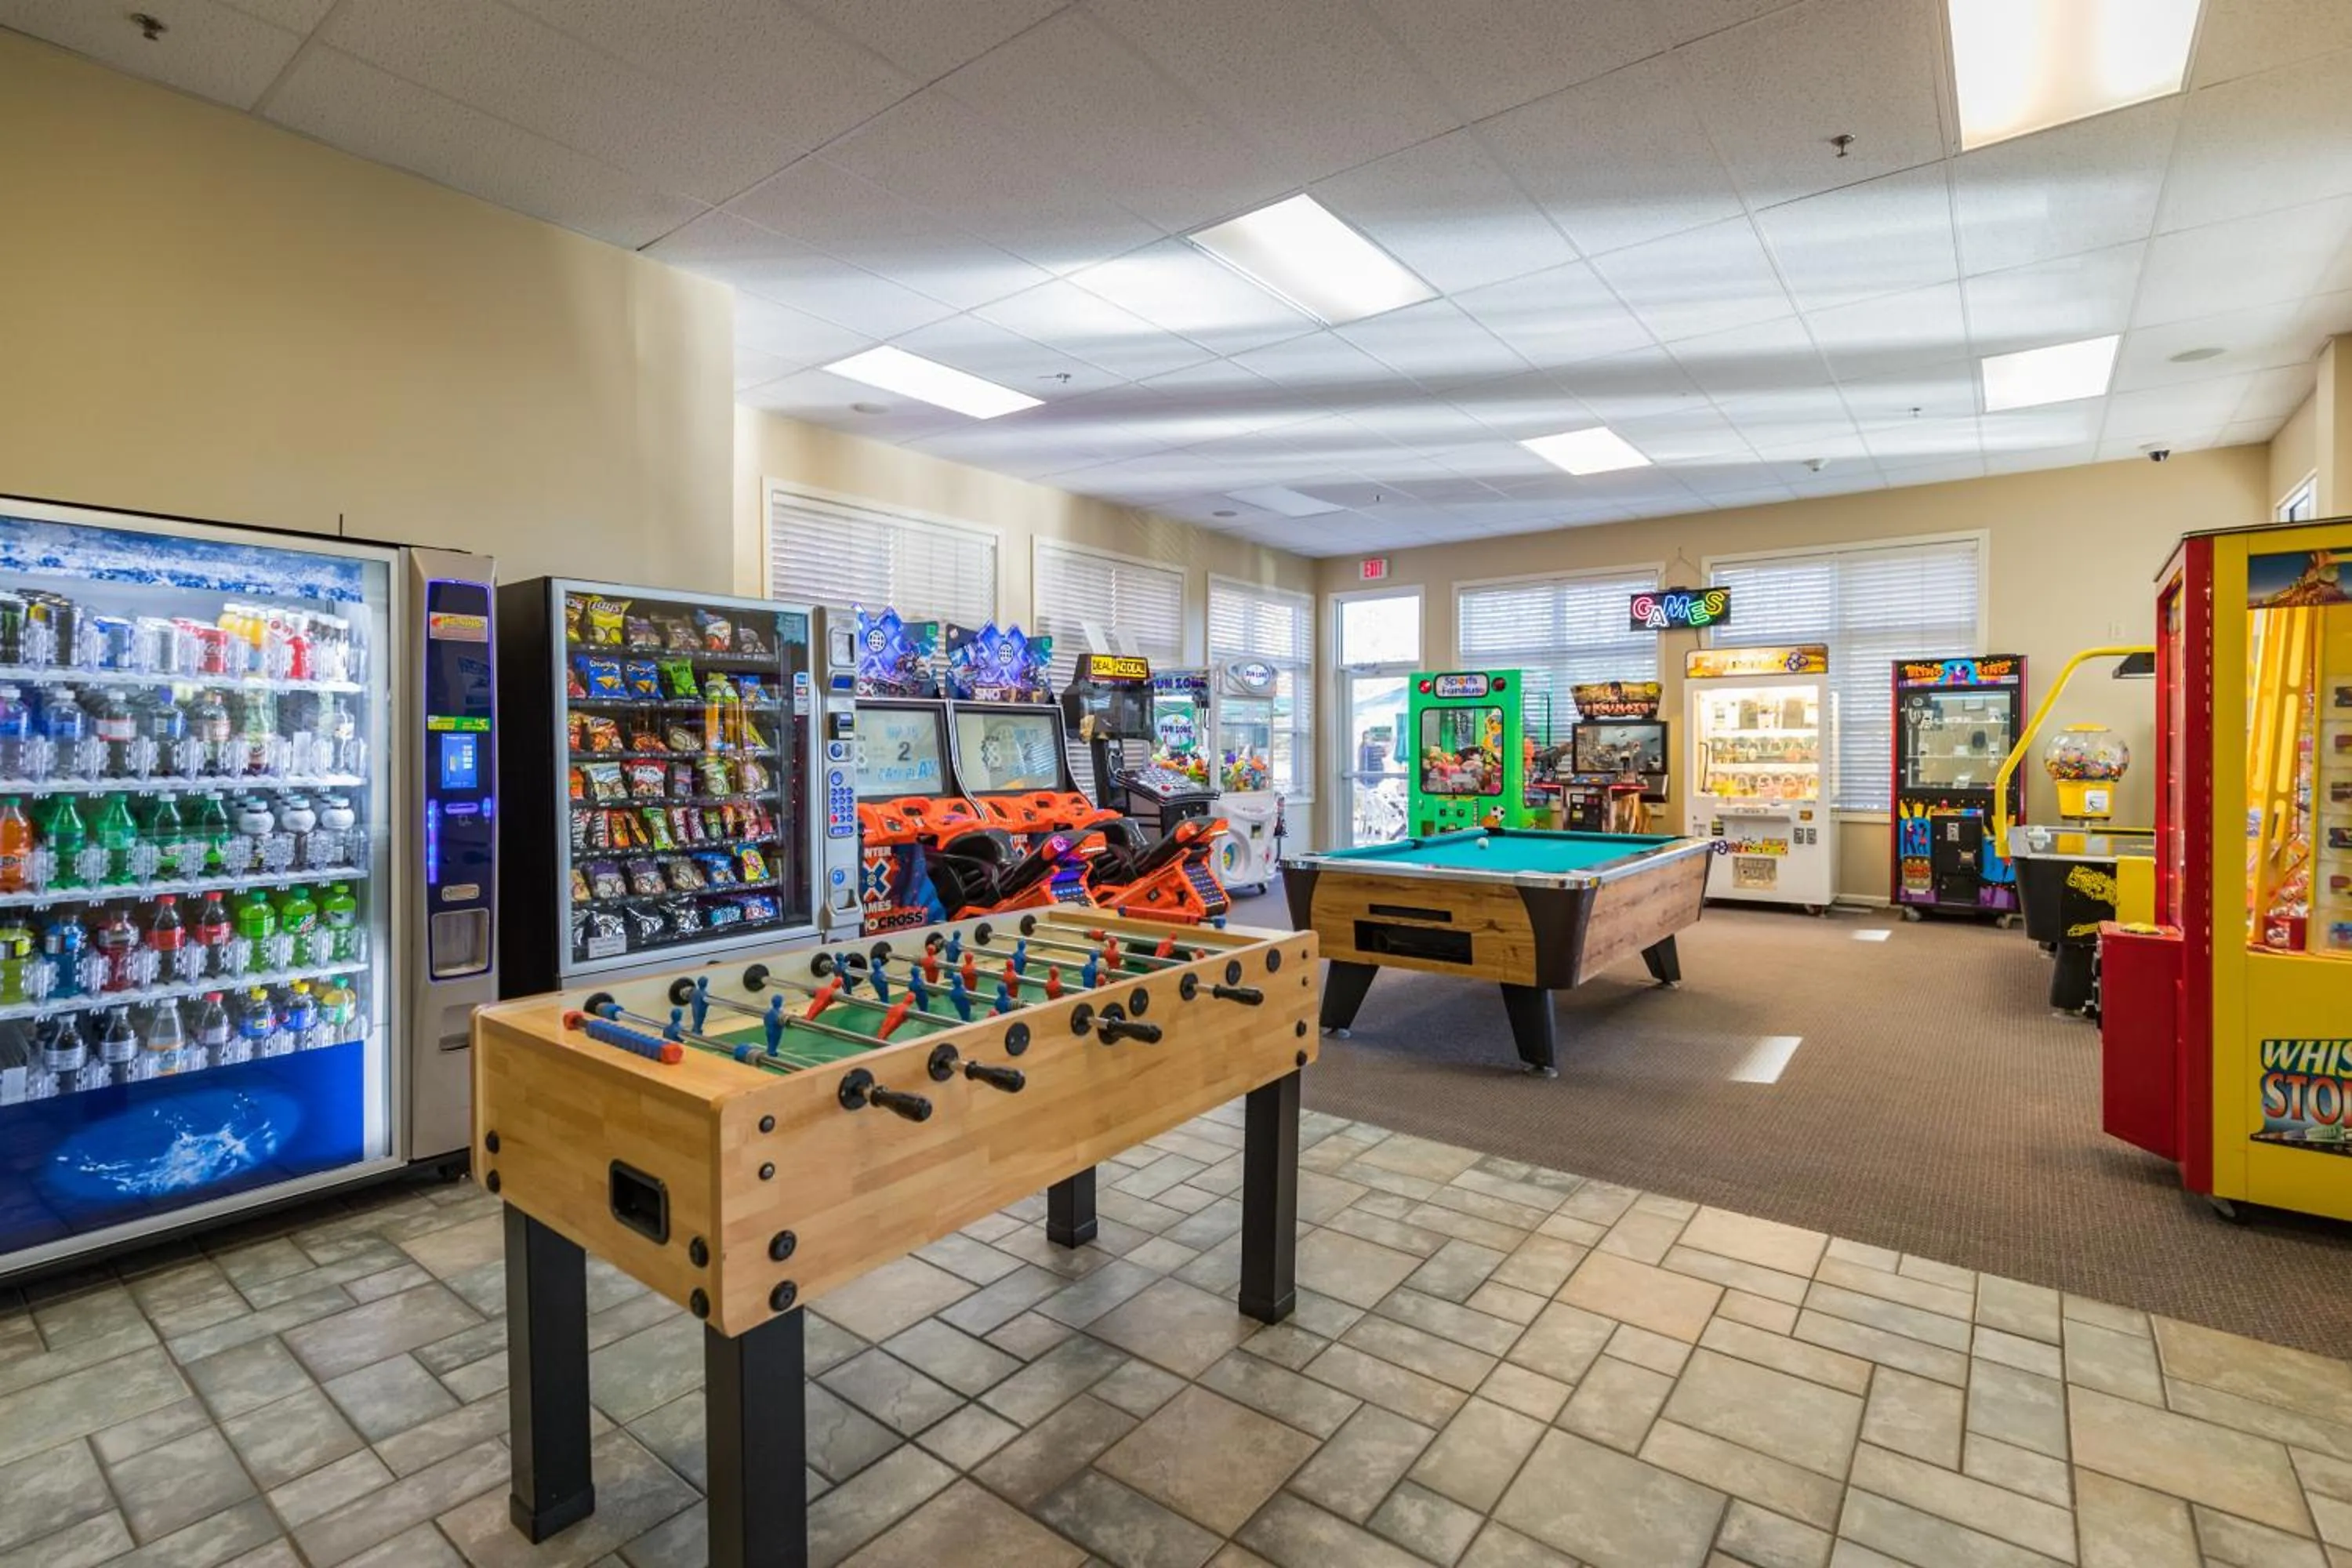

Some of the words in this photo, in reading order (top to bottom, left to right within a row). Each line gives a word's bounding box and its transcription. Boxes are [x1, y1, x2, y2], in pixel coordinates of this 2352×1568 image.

[1363, 560, 1383, 578] EXIT
[1633, 591, 1724, 627] GAMES
[1093, 659, 1112, 670] DEAL
[1127, 662, 1146, 673] DEAL
[897, 741, 911, 762] 2
[863, 899, 891, 913] AMES
